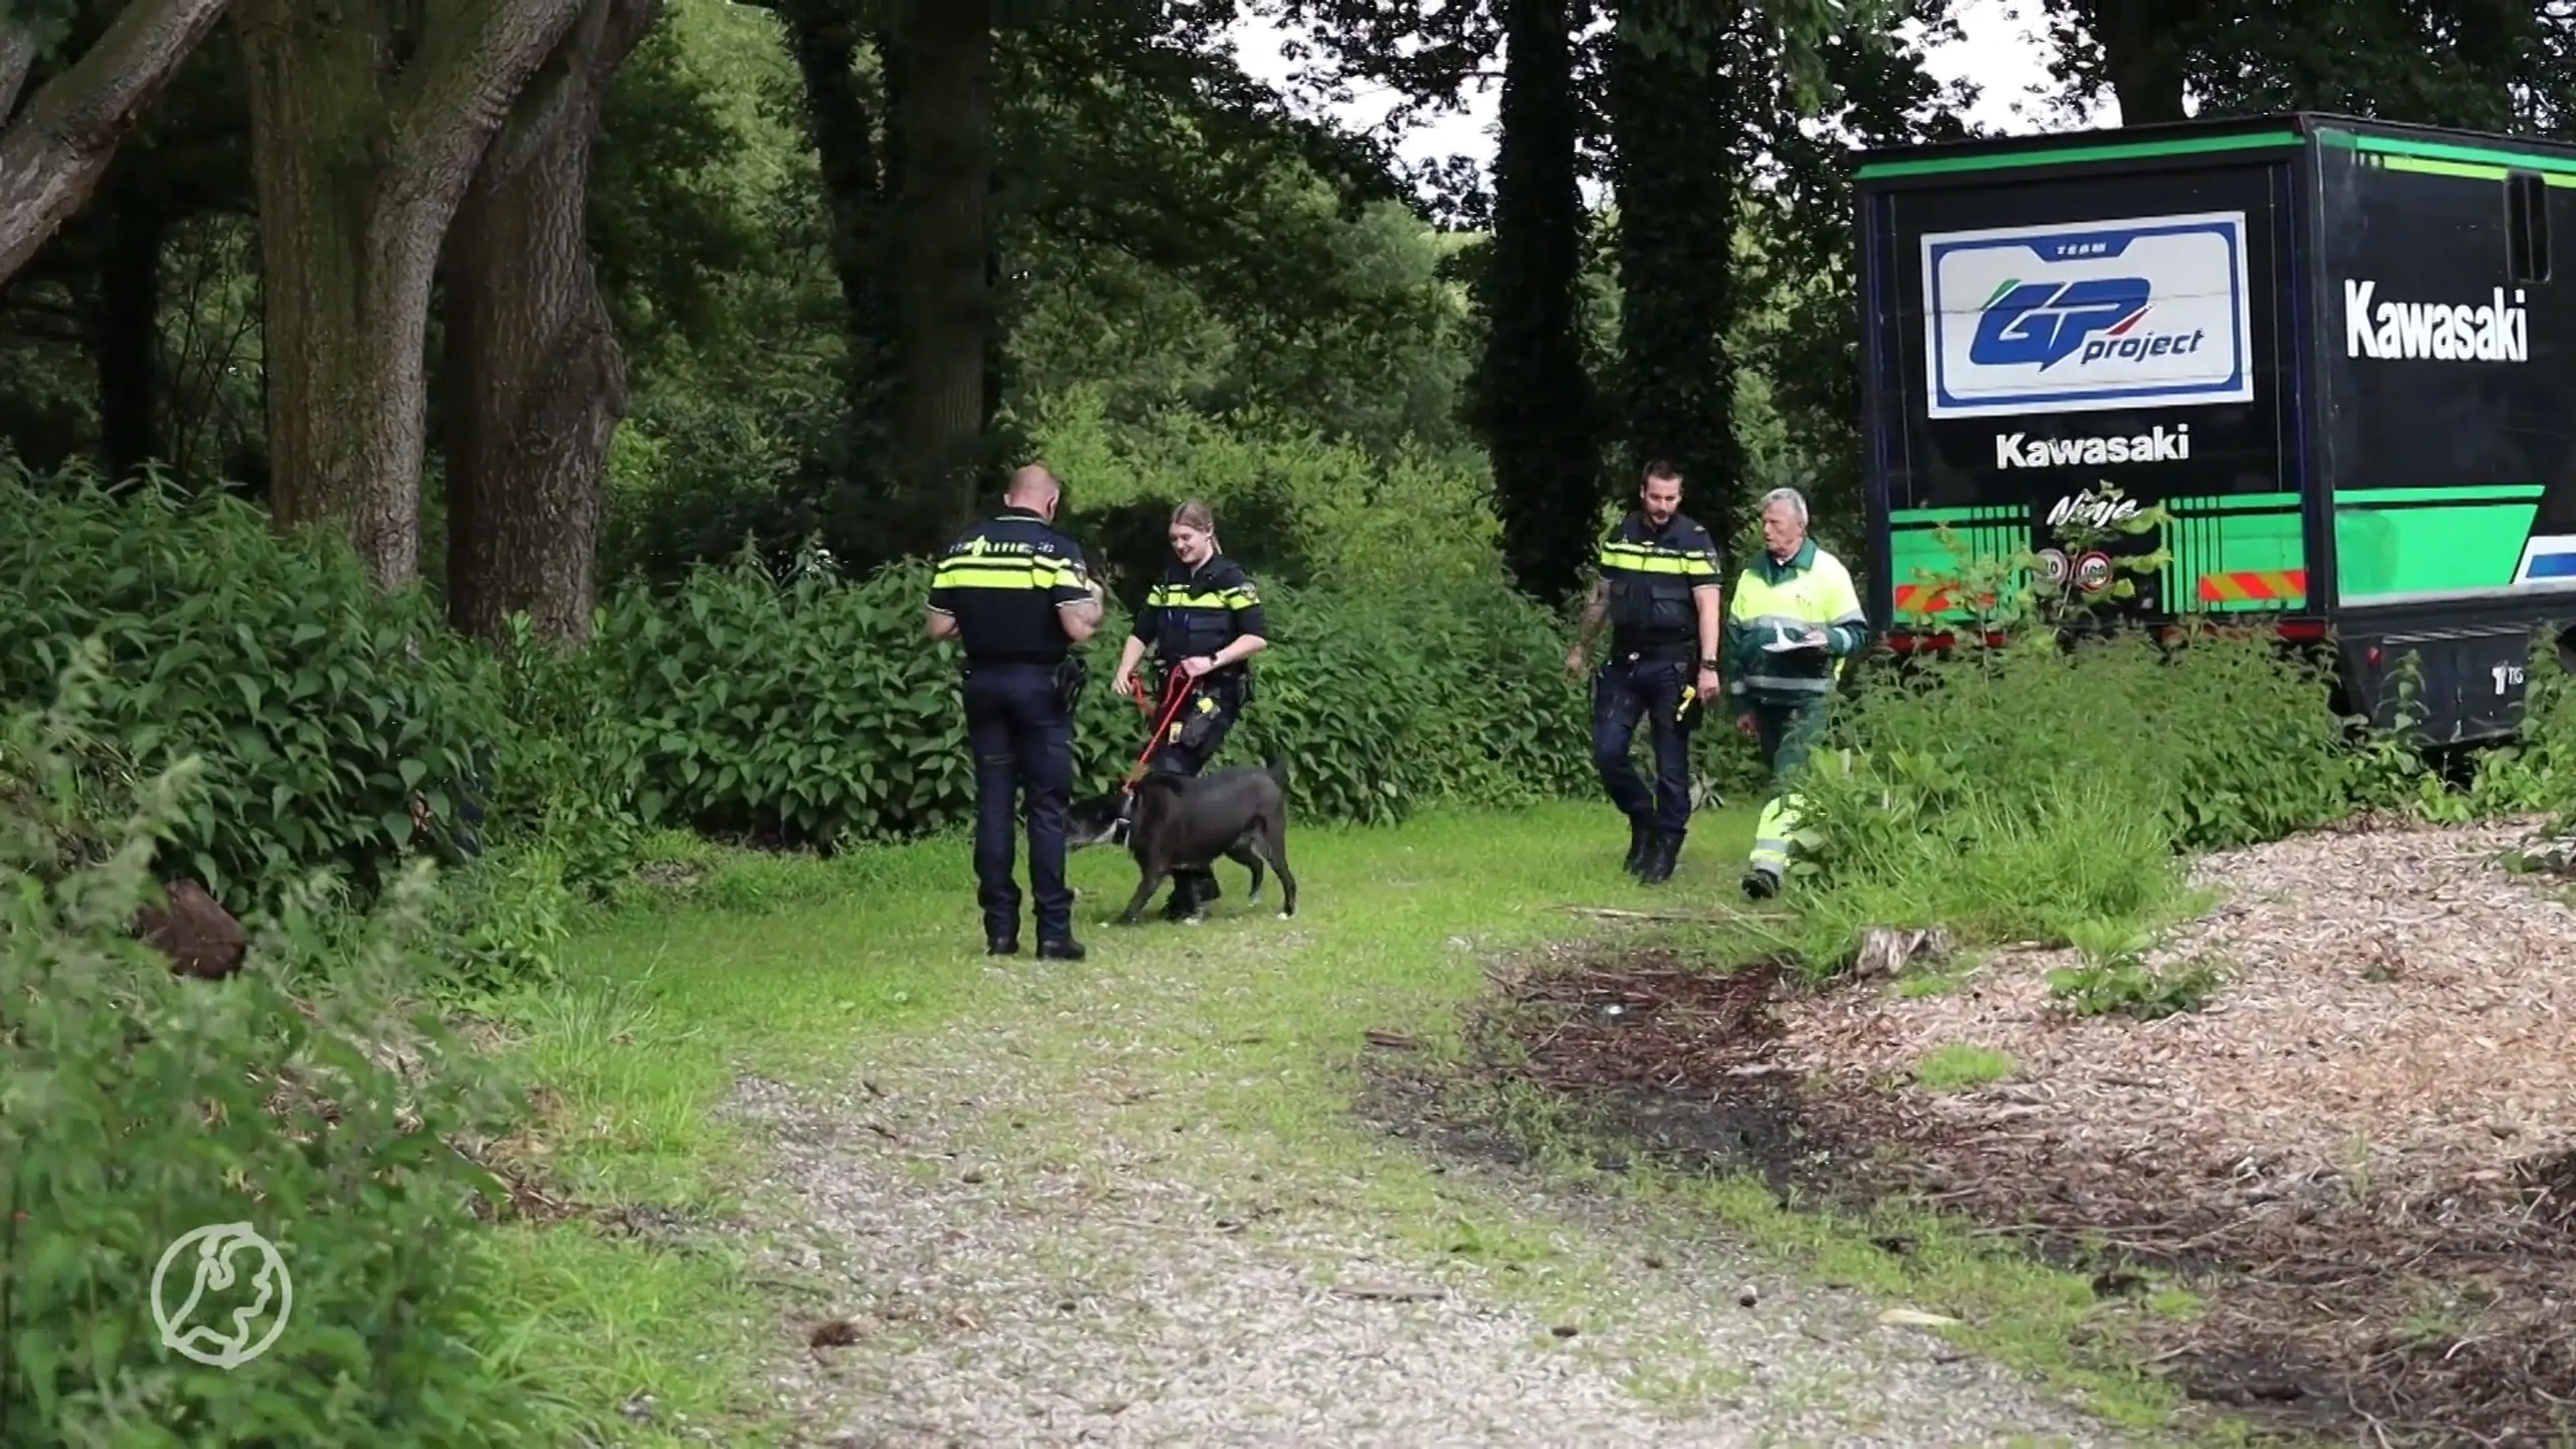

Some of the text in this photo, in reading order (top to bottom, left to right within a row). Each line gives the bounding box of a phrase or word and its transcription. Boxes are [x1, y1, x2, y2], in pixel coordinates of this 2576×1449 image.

[2057, 242, 2106, 255] TEAM
[2345, 279, 2528, 362] Kawasaki
[2080, 329, 2204, 366] project
[1996, 424, 2190, 469] Kawasaki
